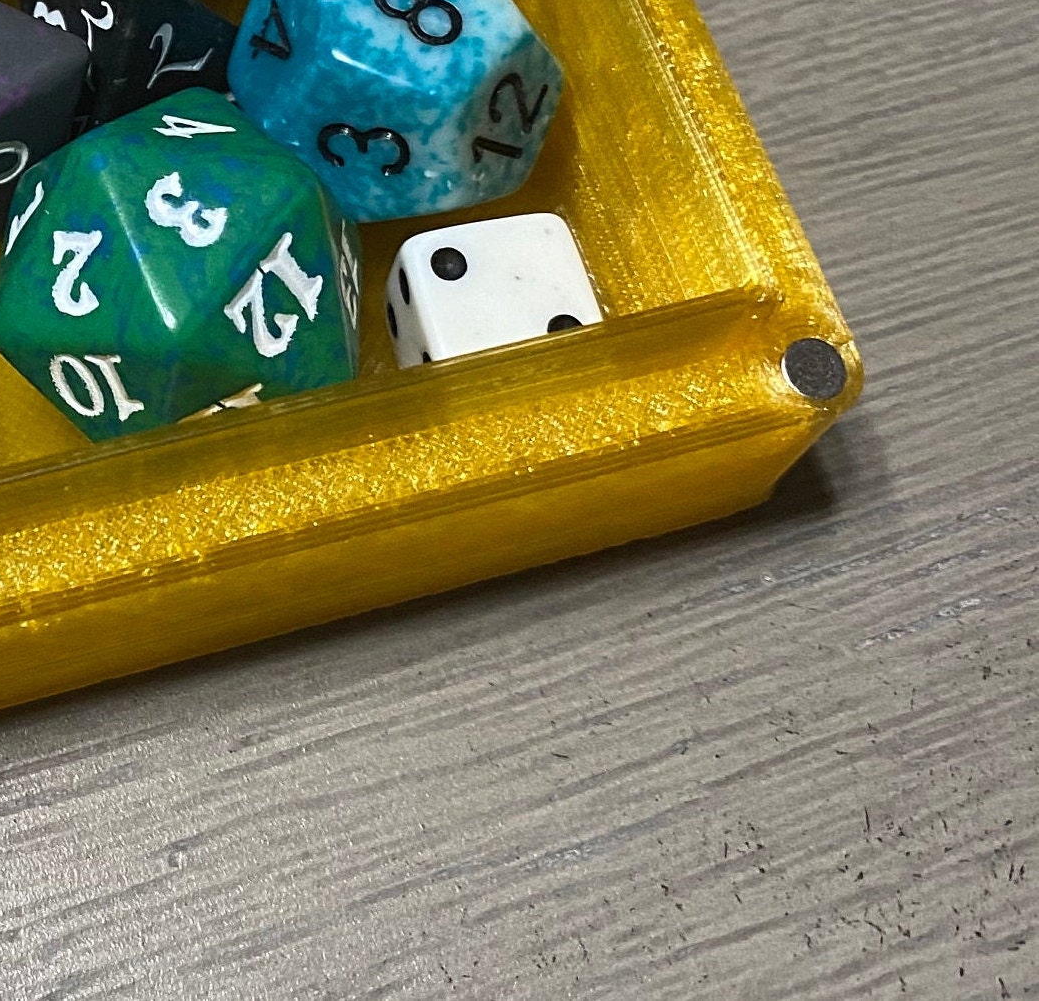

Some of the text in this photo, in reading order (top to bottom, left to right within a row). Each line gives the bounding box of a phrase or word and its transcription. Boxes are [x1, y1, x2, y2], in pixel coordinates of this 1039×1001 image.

[80, 0, 114, 52] 2
[147, 22, 214, 90] 2
[249, 0, 292, 61] 4
[152, 114, 237, 139] 4
[317, 122, 410, 176] 3
[471, 72, 549, 164] 12
[143, 171, 229, 248] 3
[51, 229, 103, 317] 2
[223, 231, 324, 359] 12
[48, 354, 145, 422] 10
